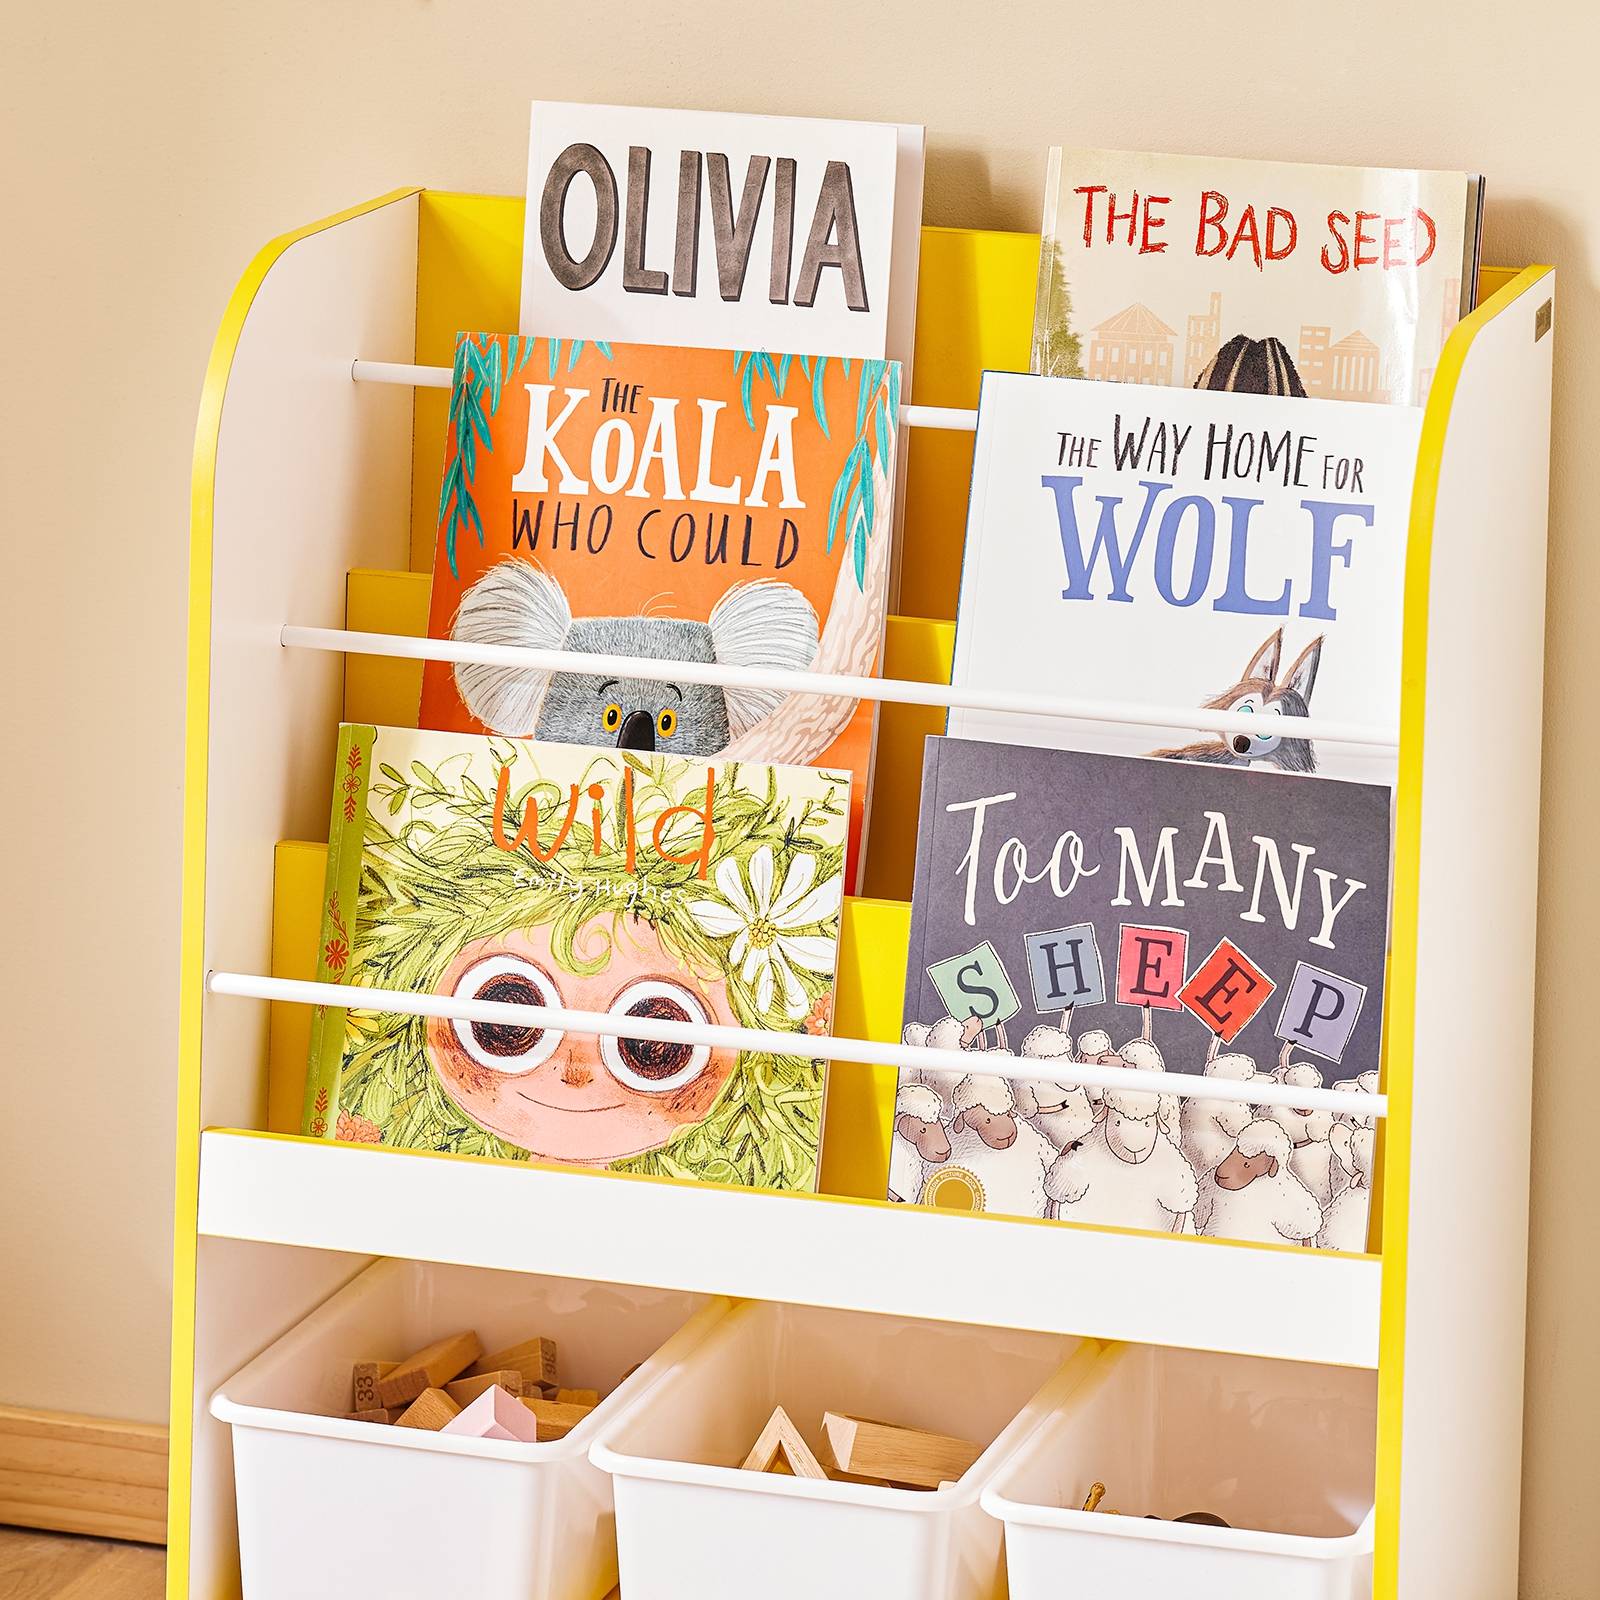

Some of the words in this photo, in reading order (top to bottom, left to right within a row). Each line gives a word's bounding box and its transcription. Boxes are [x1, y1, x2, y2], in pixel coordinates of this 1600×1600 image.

[540, 142, 870, 312] OLIVIA
[1073, 185, 1172, 255] THE
[1195, 190, 1298, 272] BAD
[1320, 207, 1437, 274] SEED
[601, 378, 644, 414] THE
[511, 383, 807, 509] KOALA
[1057, 431, 1102, 468] THE
[1113, 413, 1192, 476] WAY
[1203, 423, 1318, 488] HOME
[1322, 454, 1365, 493] FOR
[511, 498, 613, 555] WHO
[637, 508, 800, 569] COULD
[1041, 474, 1375, 621] WOLF
[513, 867, 583, 901] Emily
[595, 874, 689, 908] Hughes
[1110, 810, 1367, 950] MANY
[956, 936, 1345, 1039] SHEEP
[356, 1375, 374, 1402] 33
